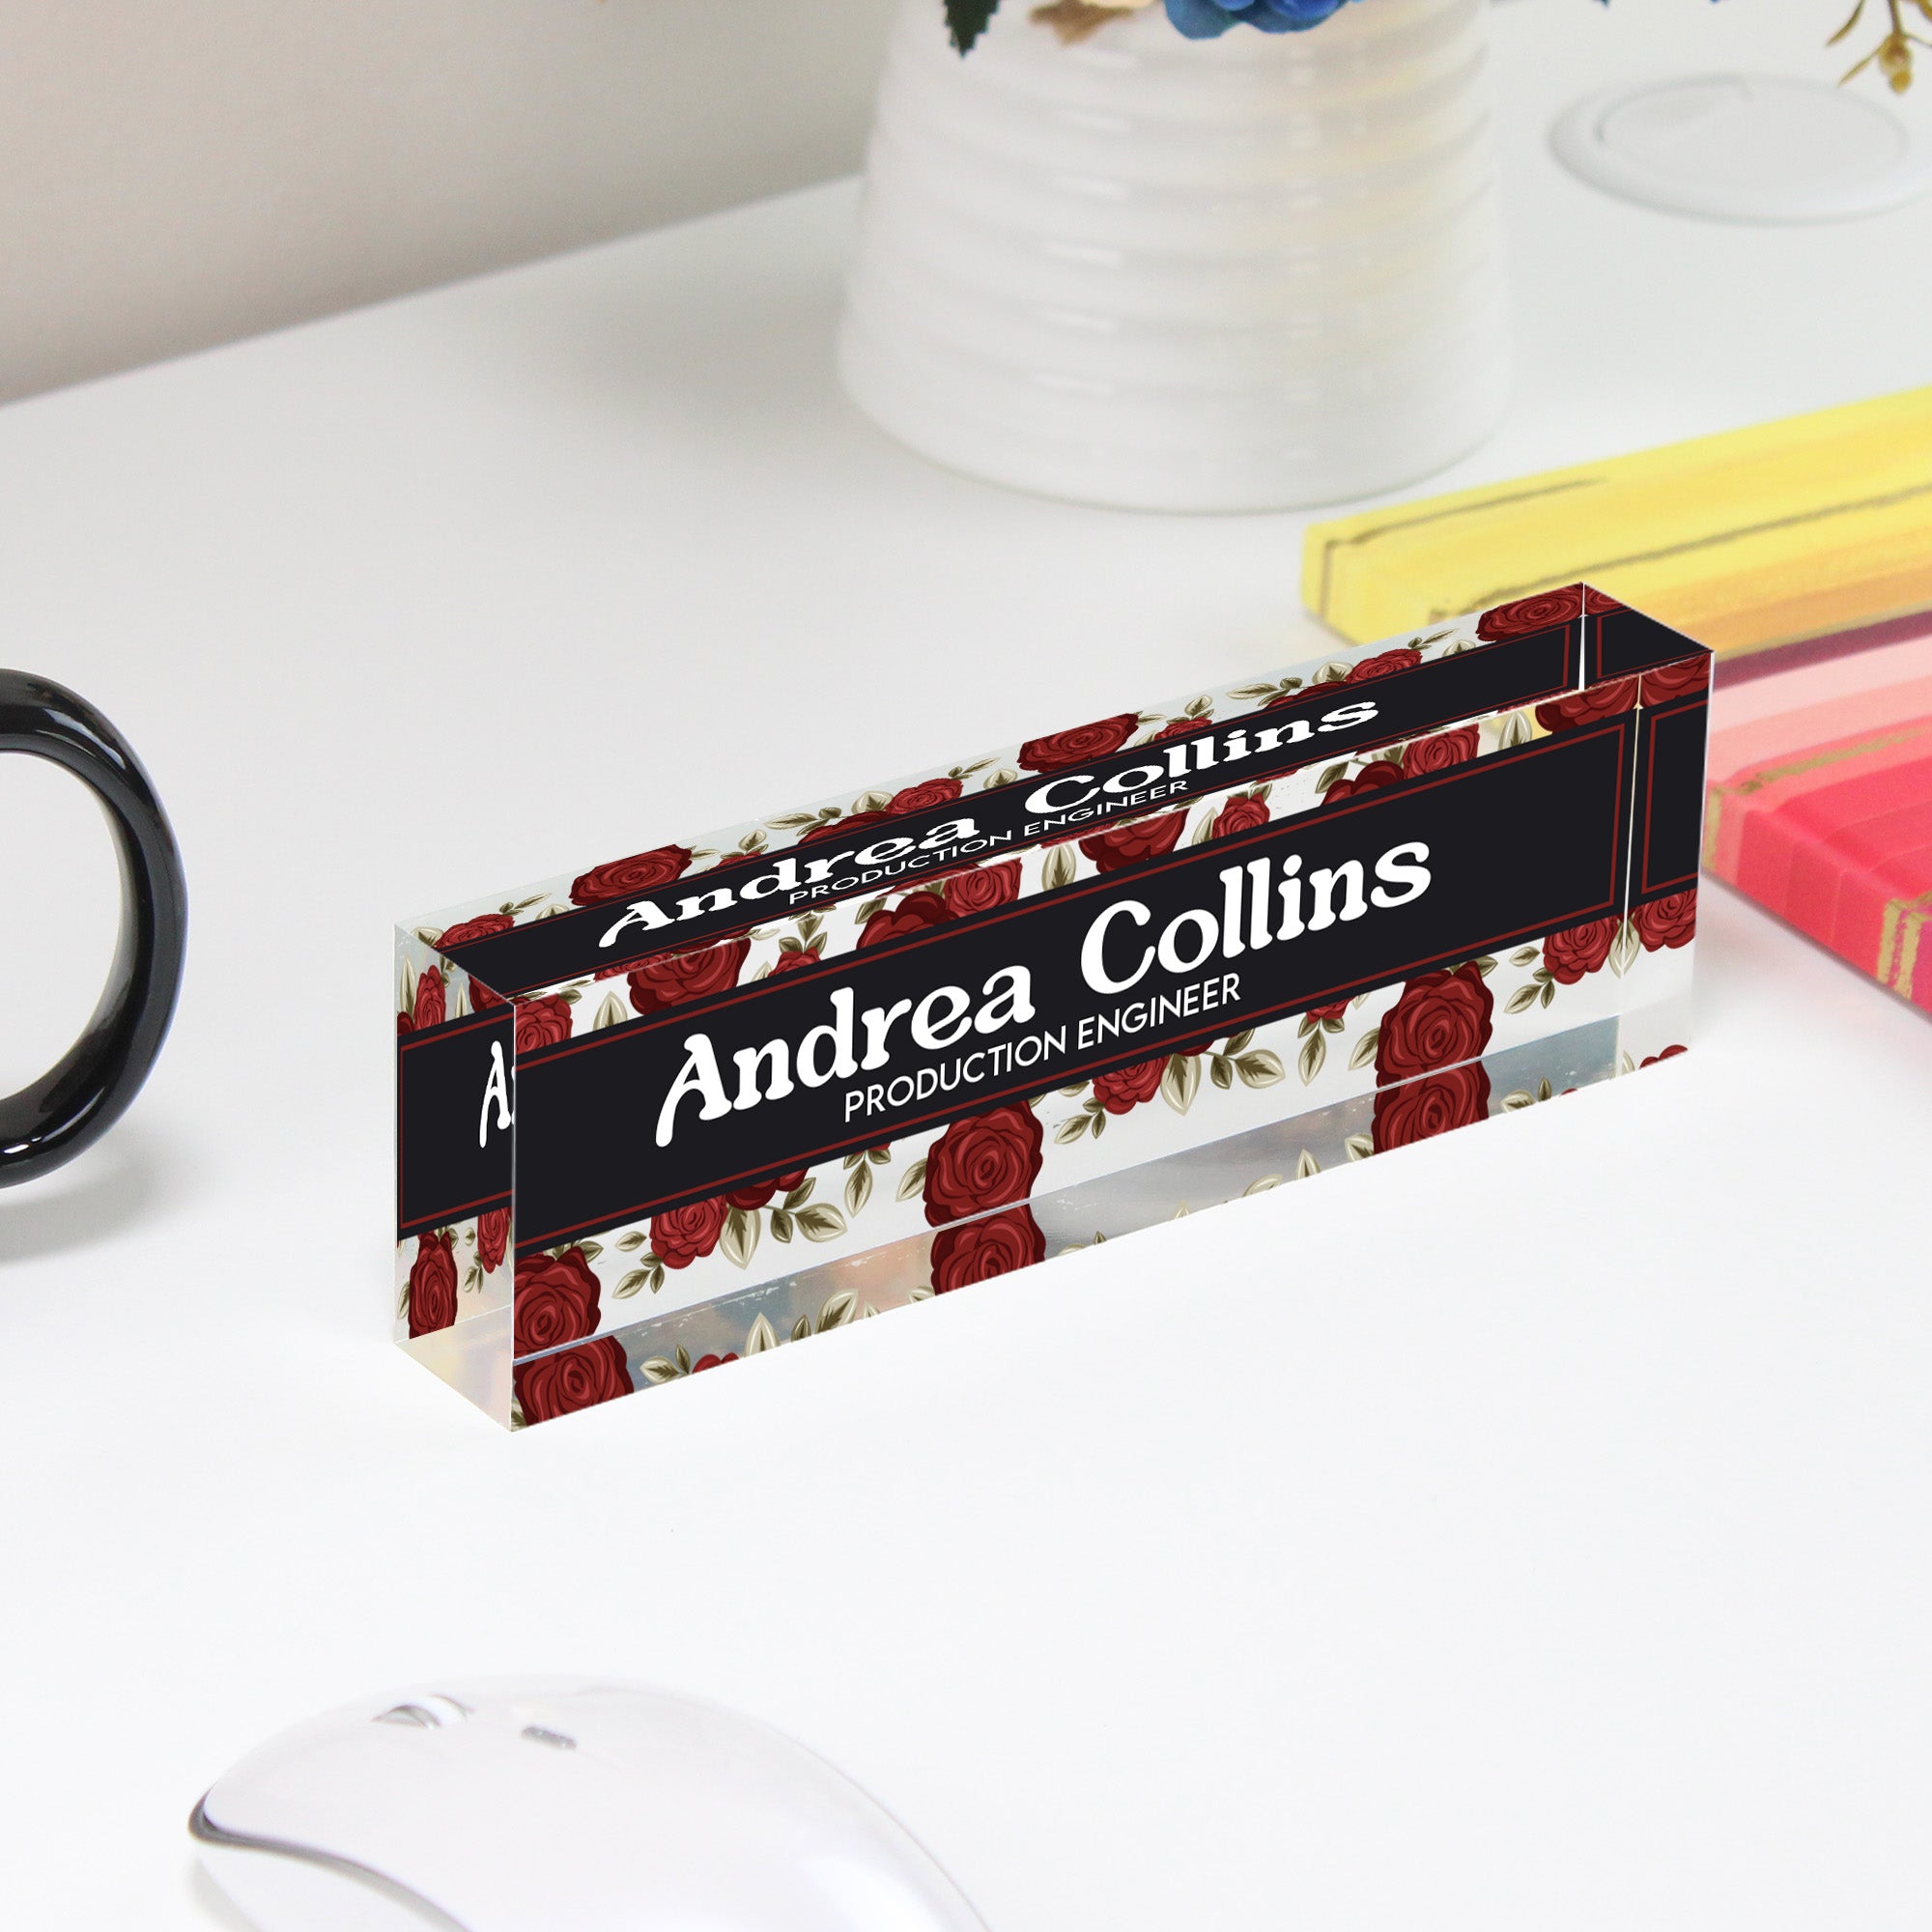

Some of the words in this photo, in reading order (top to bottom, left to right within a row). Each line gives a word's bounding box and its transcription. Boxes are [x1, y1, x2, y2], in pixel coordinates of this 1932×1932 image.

[599, 817, 980, 949] Andrea
[1025, 701, 1379, 813] Collins
[790, 830, 1012, 905] PRODUCTION
[1024, 780, 1189, 838] ENGINEER
[656, 966, 1036, 1147] Andrea
[1081, 841, 1432, 995] Collins
[845, 1024, 1066, 1123] PRODUCTION
[1077, 972, 1241, 1050] ENGINEER
